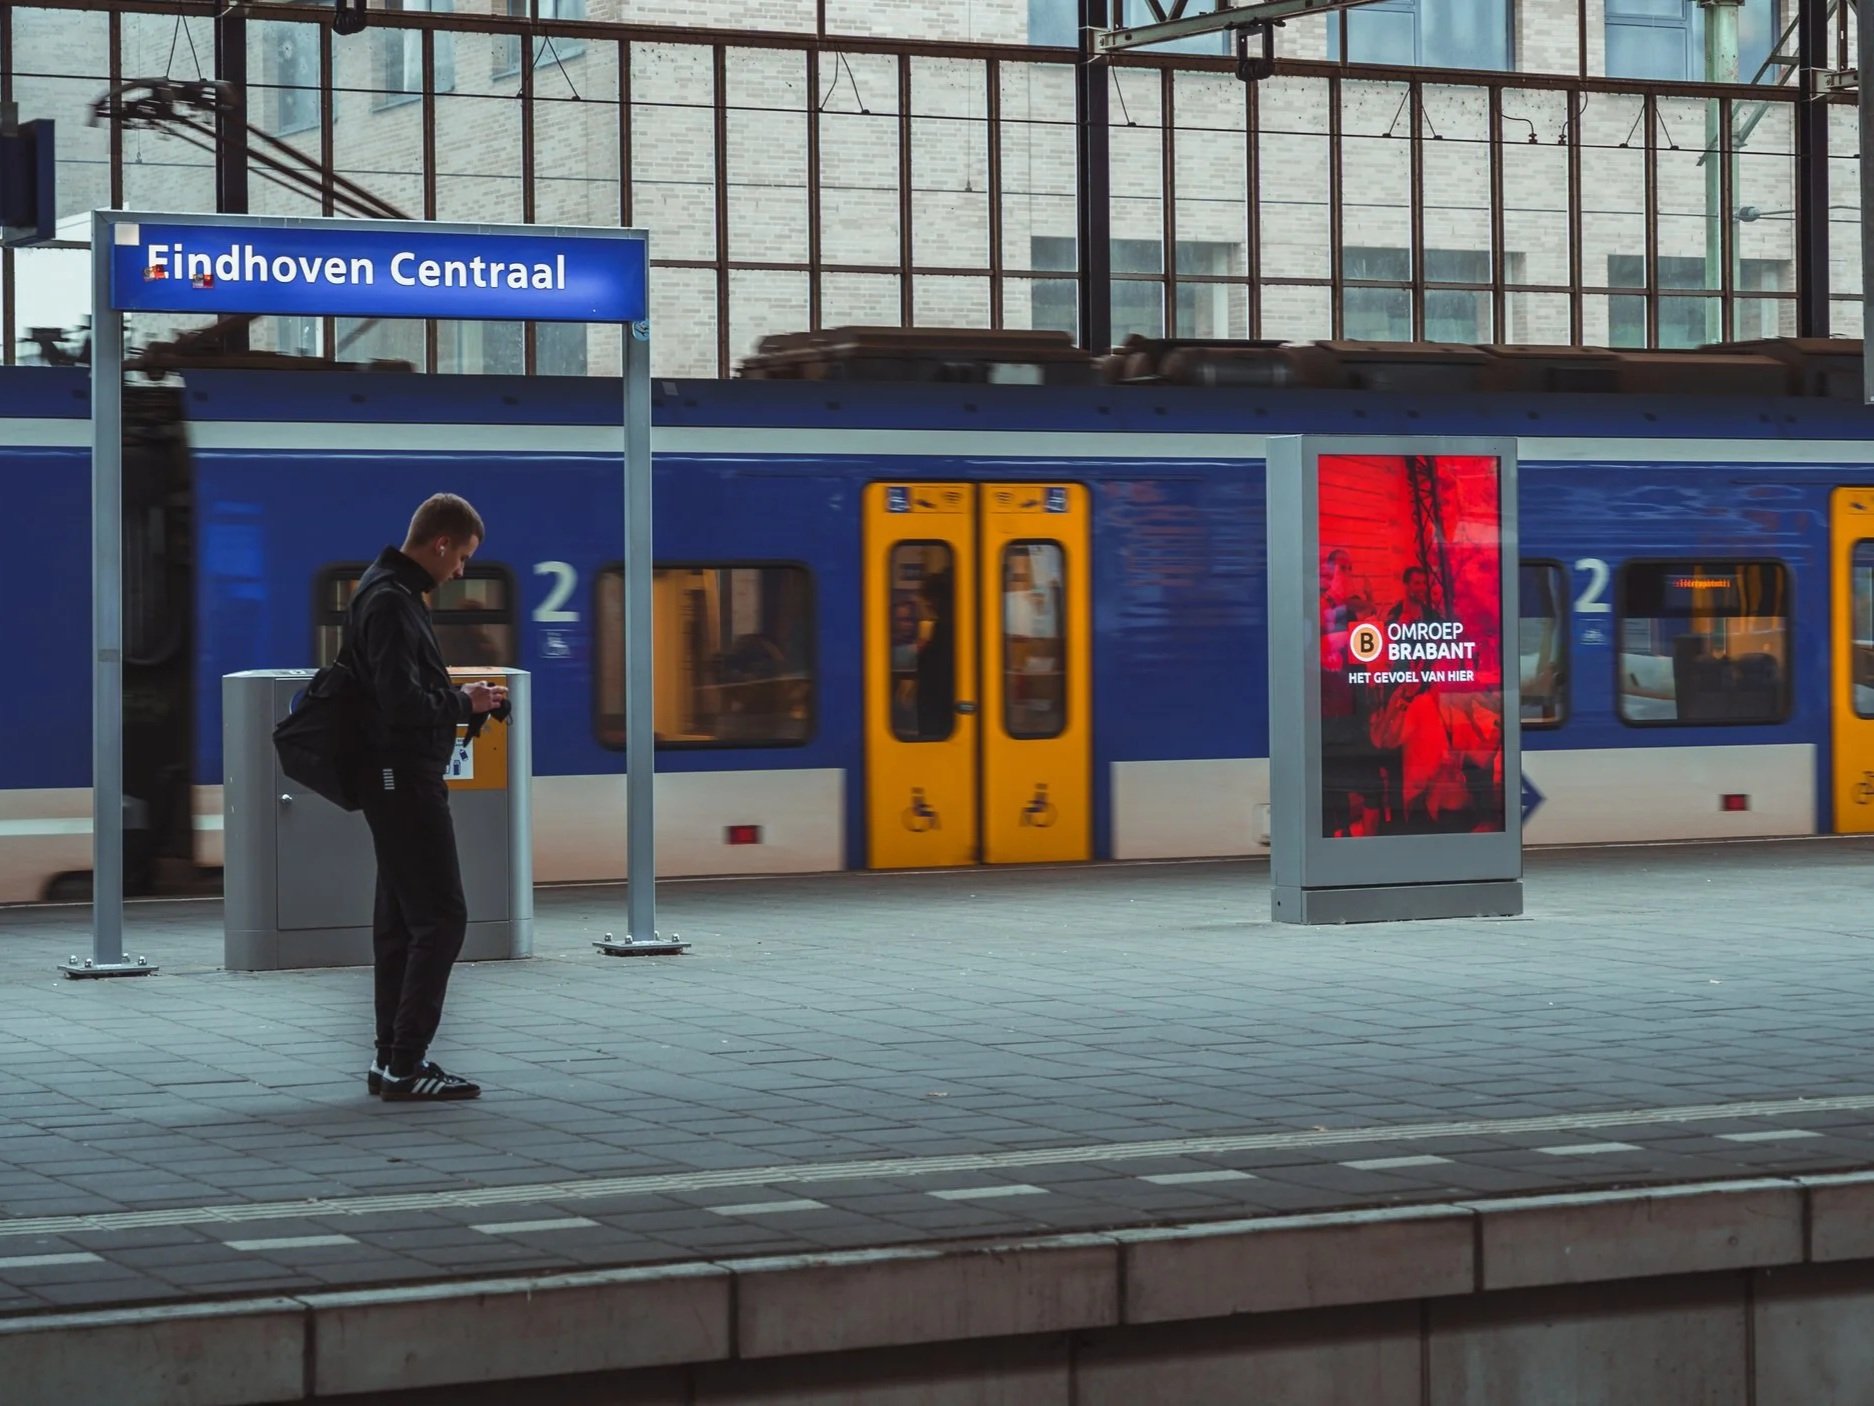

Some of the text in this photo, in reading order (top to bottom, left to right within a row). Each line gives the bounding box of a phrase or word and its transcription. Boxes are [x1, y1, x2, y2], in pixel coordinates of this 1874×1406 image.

[147, 243, 565, 291] Eindhoven Centraal
[533, 560, 579, 623] 2
[1574, 557, 1611, 613] 2
[1387, 622, 1463, 640] OMROEP
[1360, 632, 1375, 653] B
[1388, 642, 1475, 660] BRABANT
[1348, 670, 1474, 683] HET GEVOEL VAN HIER
